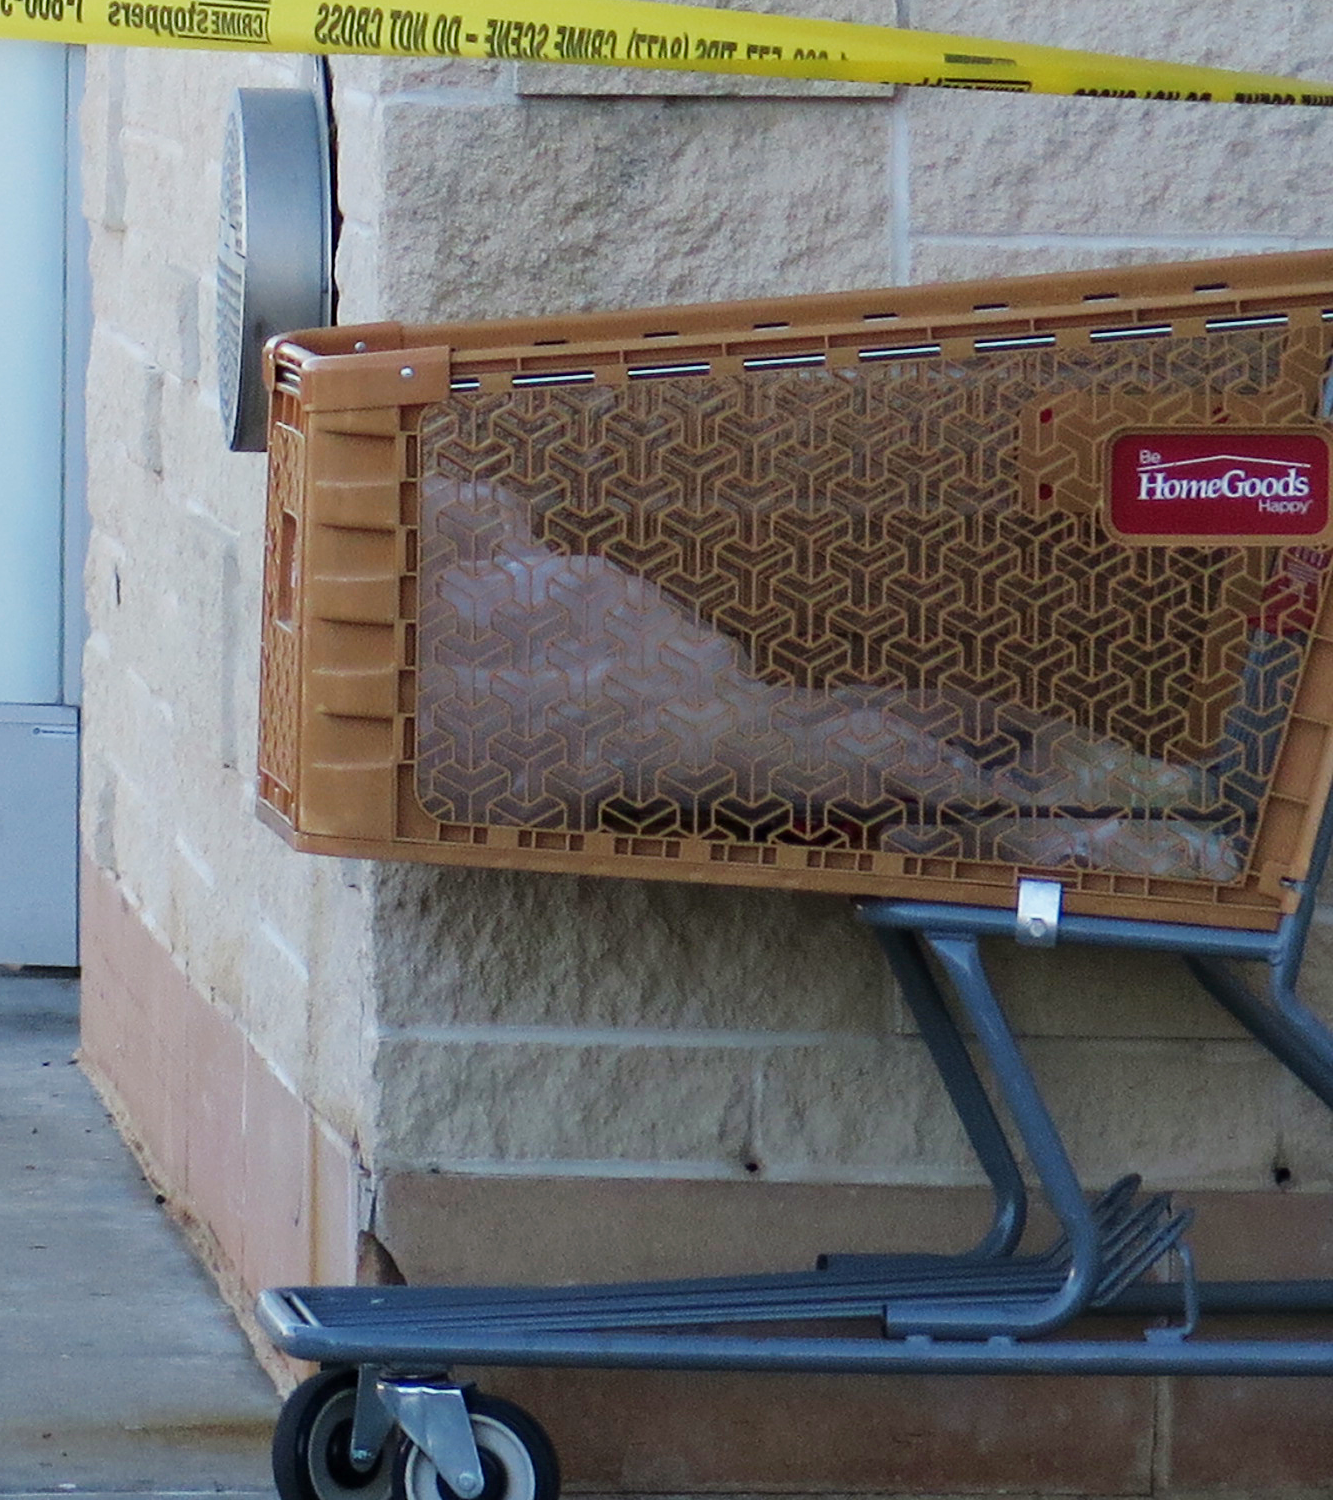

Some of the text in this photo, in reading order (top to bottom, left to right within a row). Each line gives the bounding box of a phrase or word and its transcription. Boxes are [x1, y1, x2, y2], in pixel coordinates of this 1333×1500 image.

[1139, 450, 1162, 464] Be
[1137, 467, 1311, 500] HomeGoods
[1259, 500, 1308, 515] Happy
